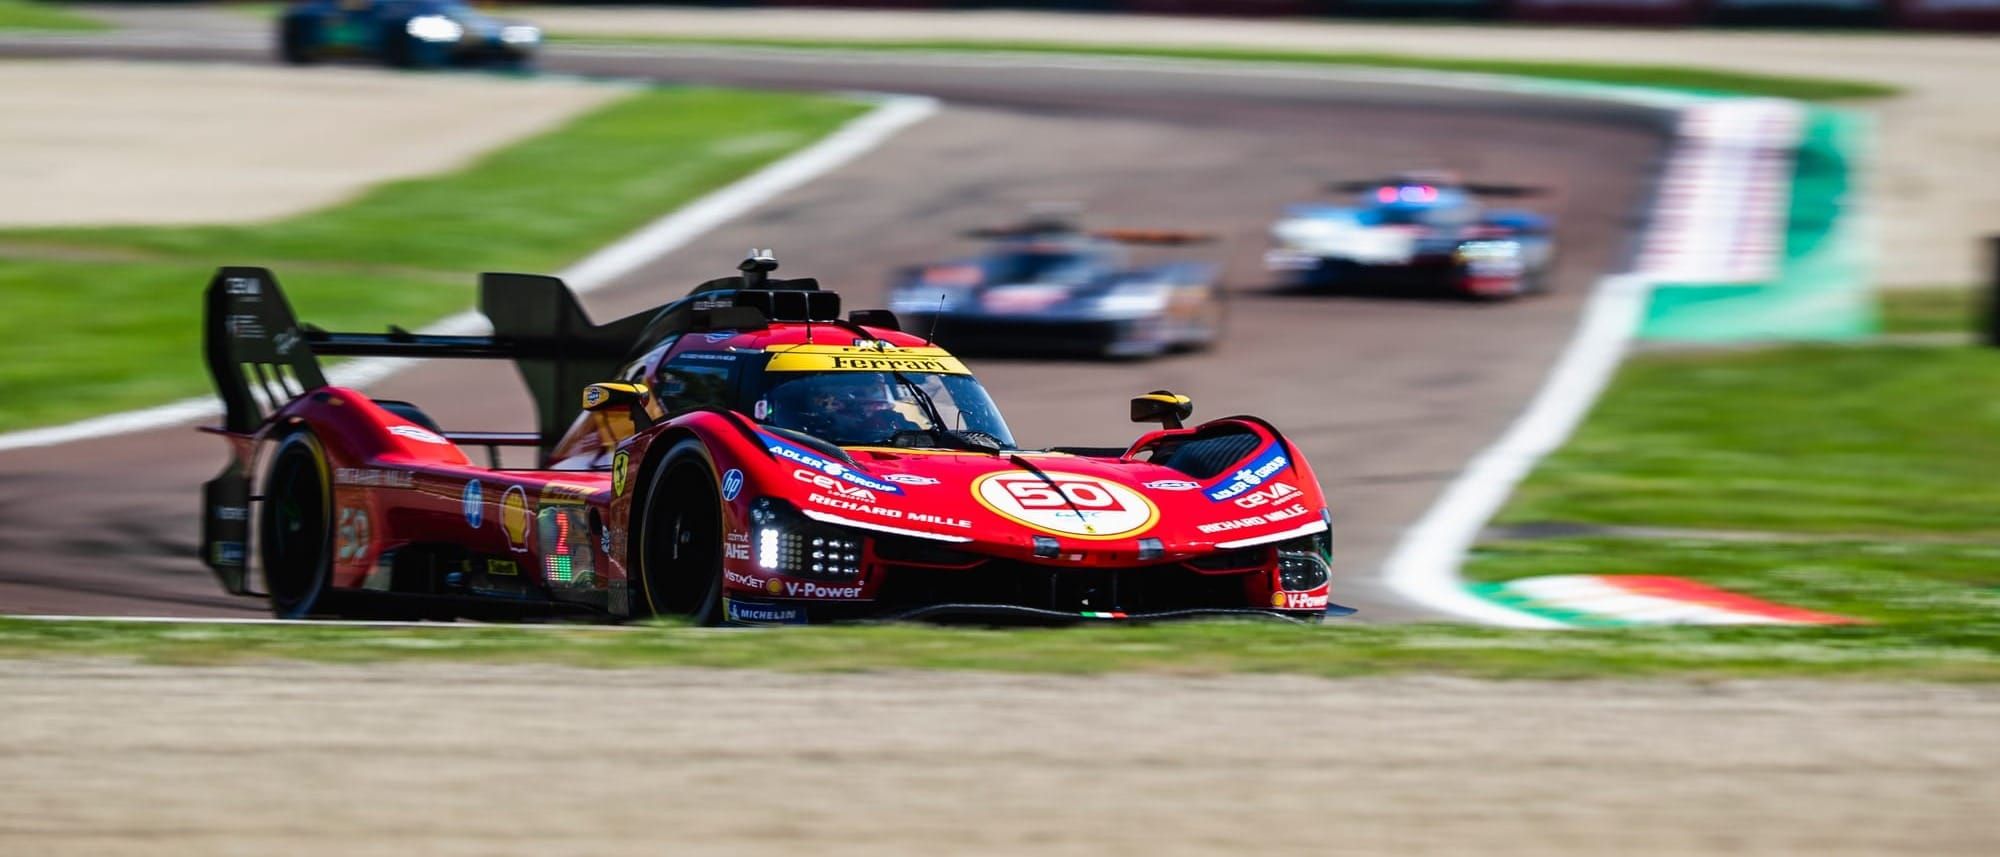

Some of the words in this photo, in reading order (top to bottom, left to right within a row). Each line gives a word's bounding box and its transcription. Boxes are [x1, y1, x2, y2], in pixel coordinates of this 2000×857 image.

[829, 356, 949, 371] Ferrari
[769, 445, 824, 471] ADLER
[843, 473, 897, 492] GROUP
[1211, 482, 1250, 500] ADLER
[1254, 456, 1287, 478] GROUP
[722, 471, 742, 501] hp
[1006, 481, 1114, 507] 50
[808, 493, 903, 518] RICHARD
[907, 512, 974, 529] MILLE
[1197, 517, 1267, 533] RICHARD
[1264, 504, 1308, 522] MILLE
[556, 512, 569, 555] 2
[785, 582, 863, 598] V-Power
[740, 608, 796, 620] MICHELIN
